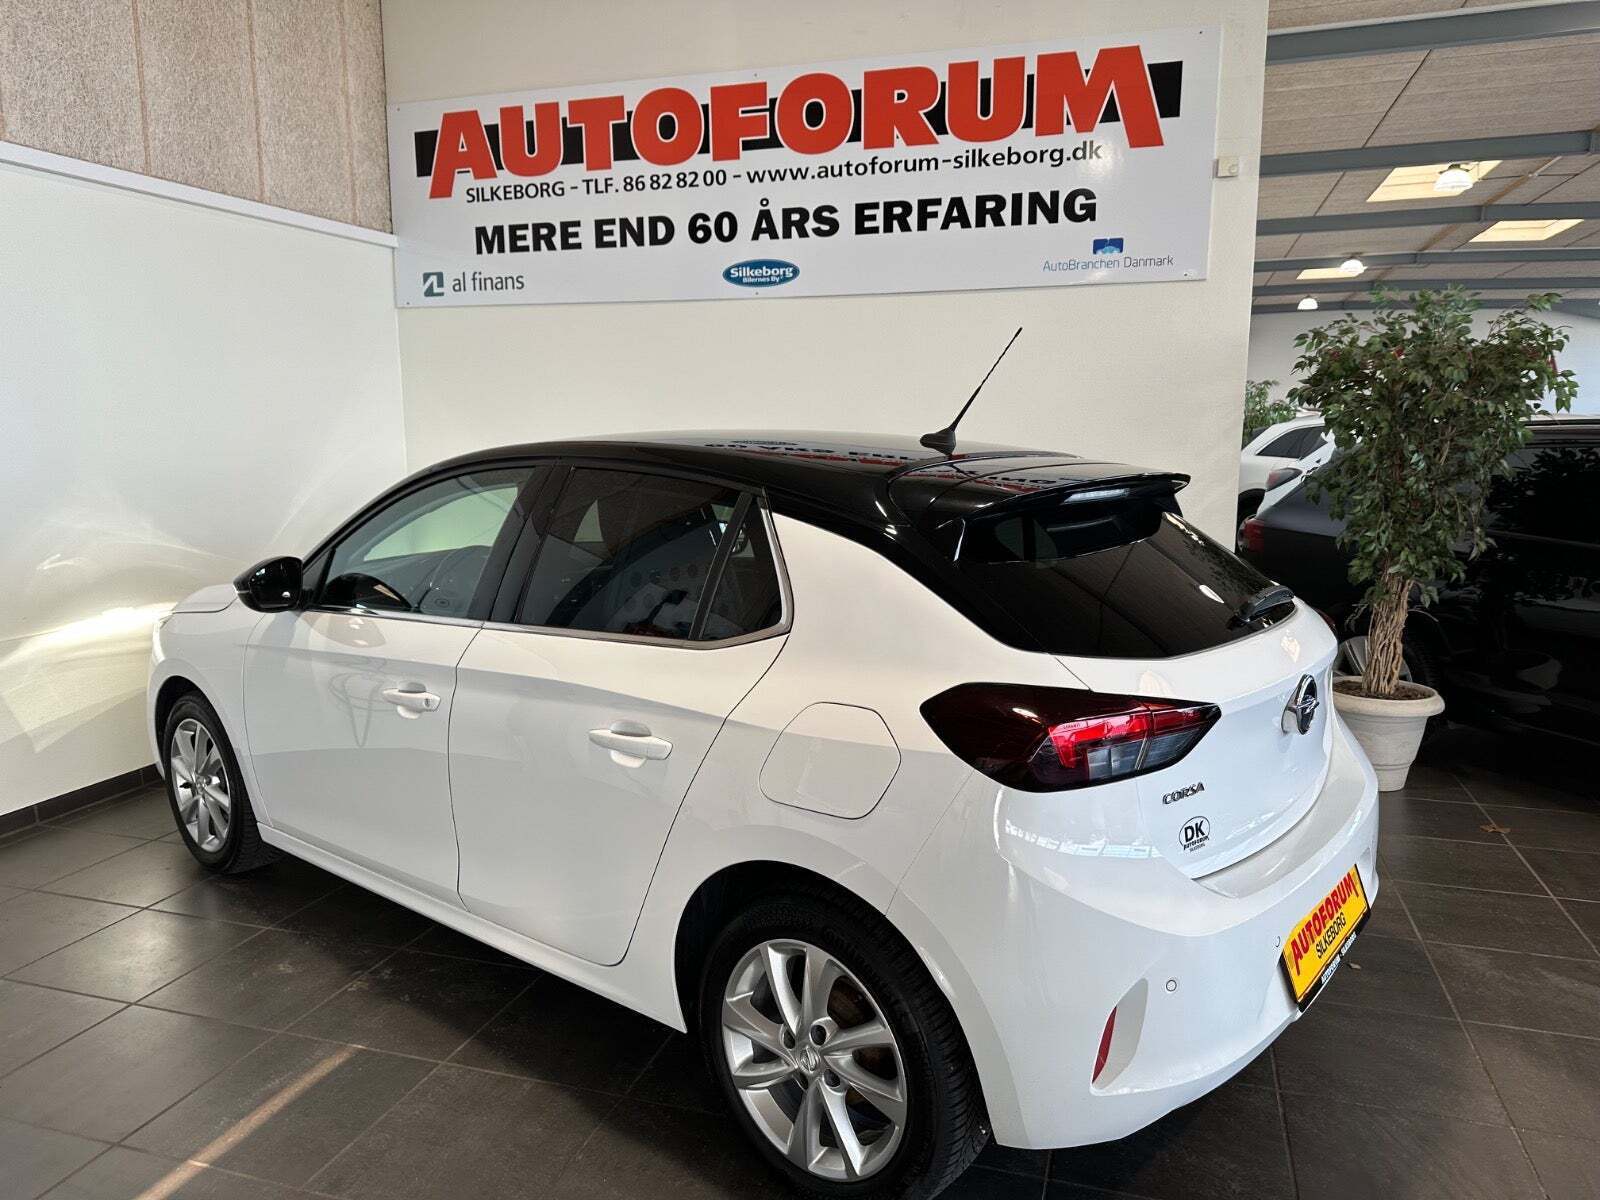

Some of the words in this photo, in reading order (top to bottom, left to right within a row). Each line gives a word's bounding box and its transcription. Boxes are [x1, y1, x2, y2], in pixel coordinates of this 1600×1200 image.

[429, 45, 1164, 199] AUTOFORUM
[466, 181, 565, 203] SILKEBORG
[582, 177, 619, 194] TLF.
[623, 175, 646, 192] 86
[649, 173, 673, 191] 82
[676, 171, 699, 189] 82
[703, 169, 727, 187] 00
[746, 139, 1103, 184] www.autoforum-silkeborg.dk
[475, 220, 582, 256] MERE
[594, 214, 676, 249] END
[687, 211, 738, 244] 60
[751, 198, 840, 242] ÅRS
[854, 187, 1097, 236] ERFARING
[730, 266, 794, 278] Silkeborg
[1043, 258, 1120, 272] AutoBranchen
[1123, 255, 1174, 268] Danmark
[452, 271, 467, 292] al
[471, 271, 525, 291] finans
[1162, 782, 1205, 805] CORSA
[1184, 820, 1206, 843] DK
[1290, 871, 1359, 977] AUTOFORUM
[1315, 911, 1347, 959] SILKEBORG
